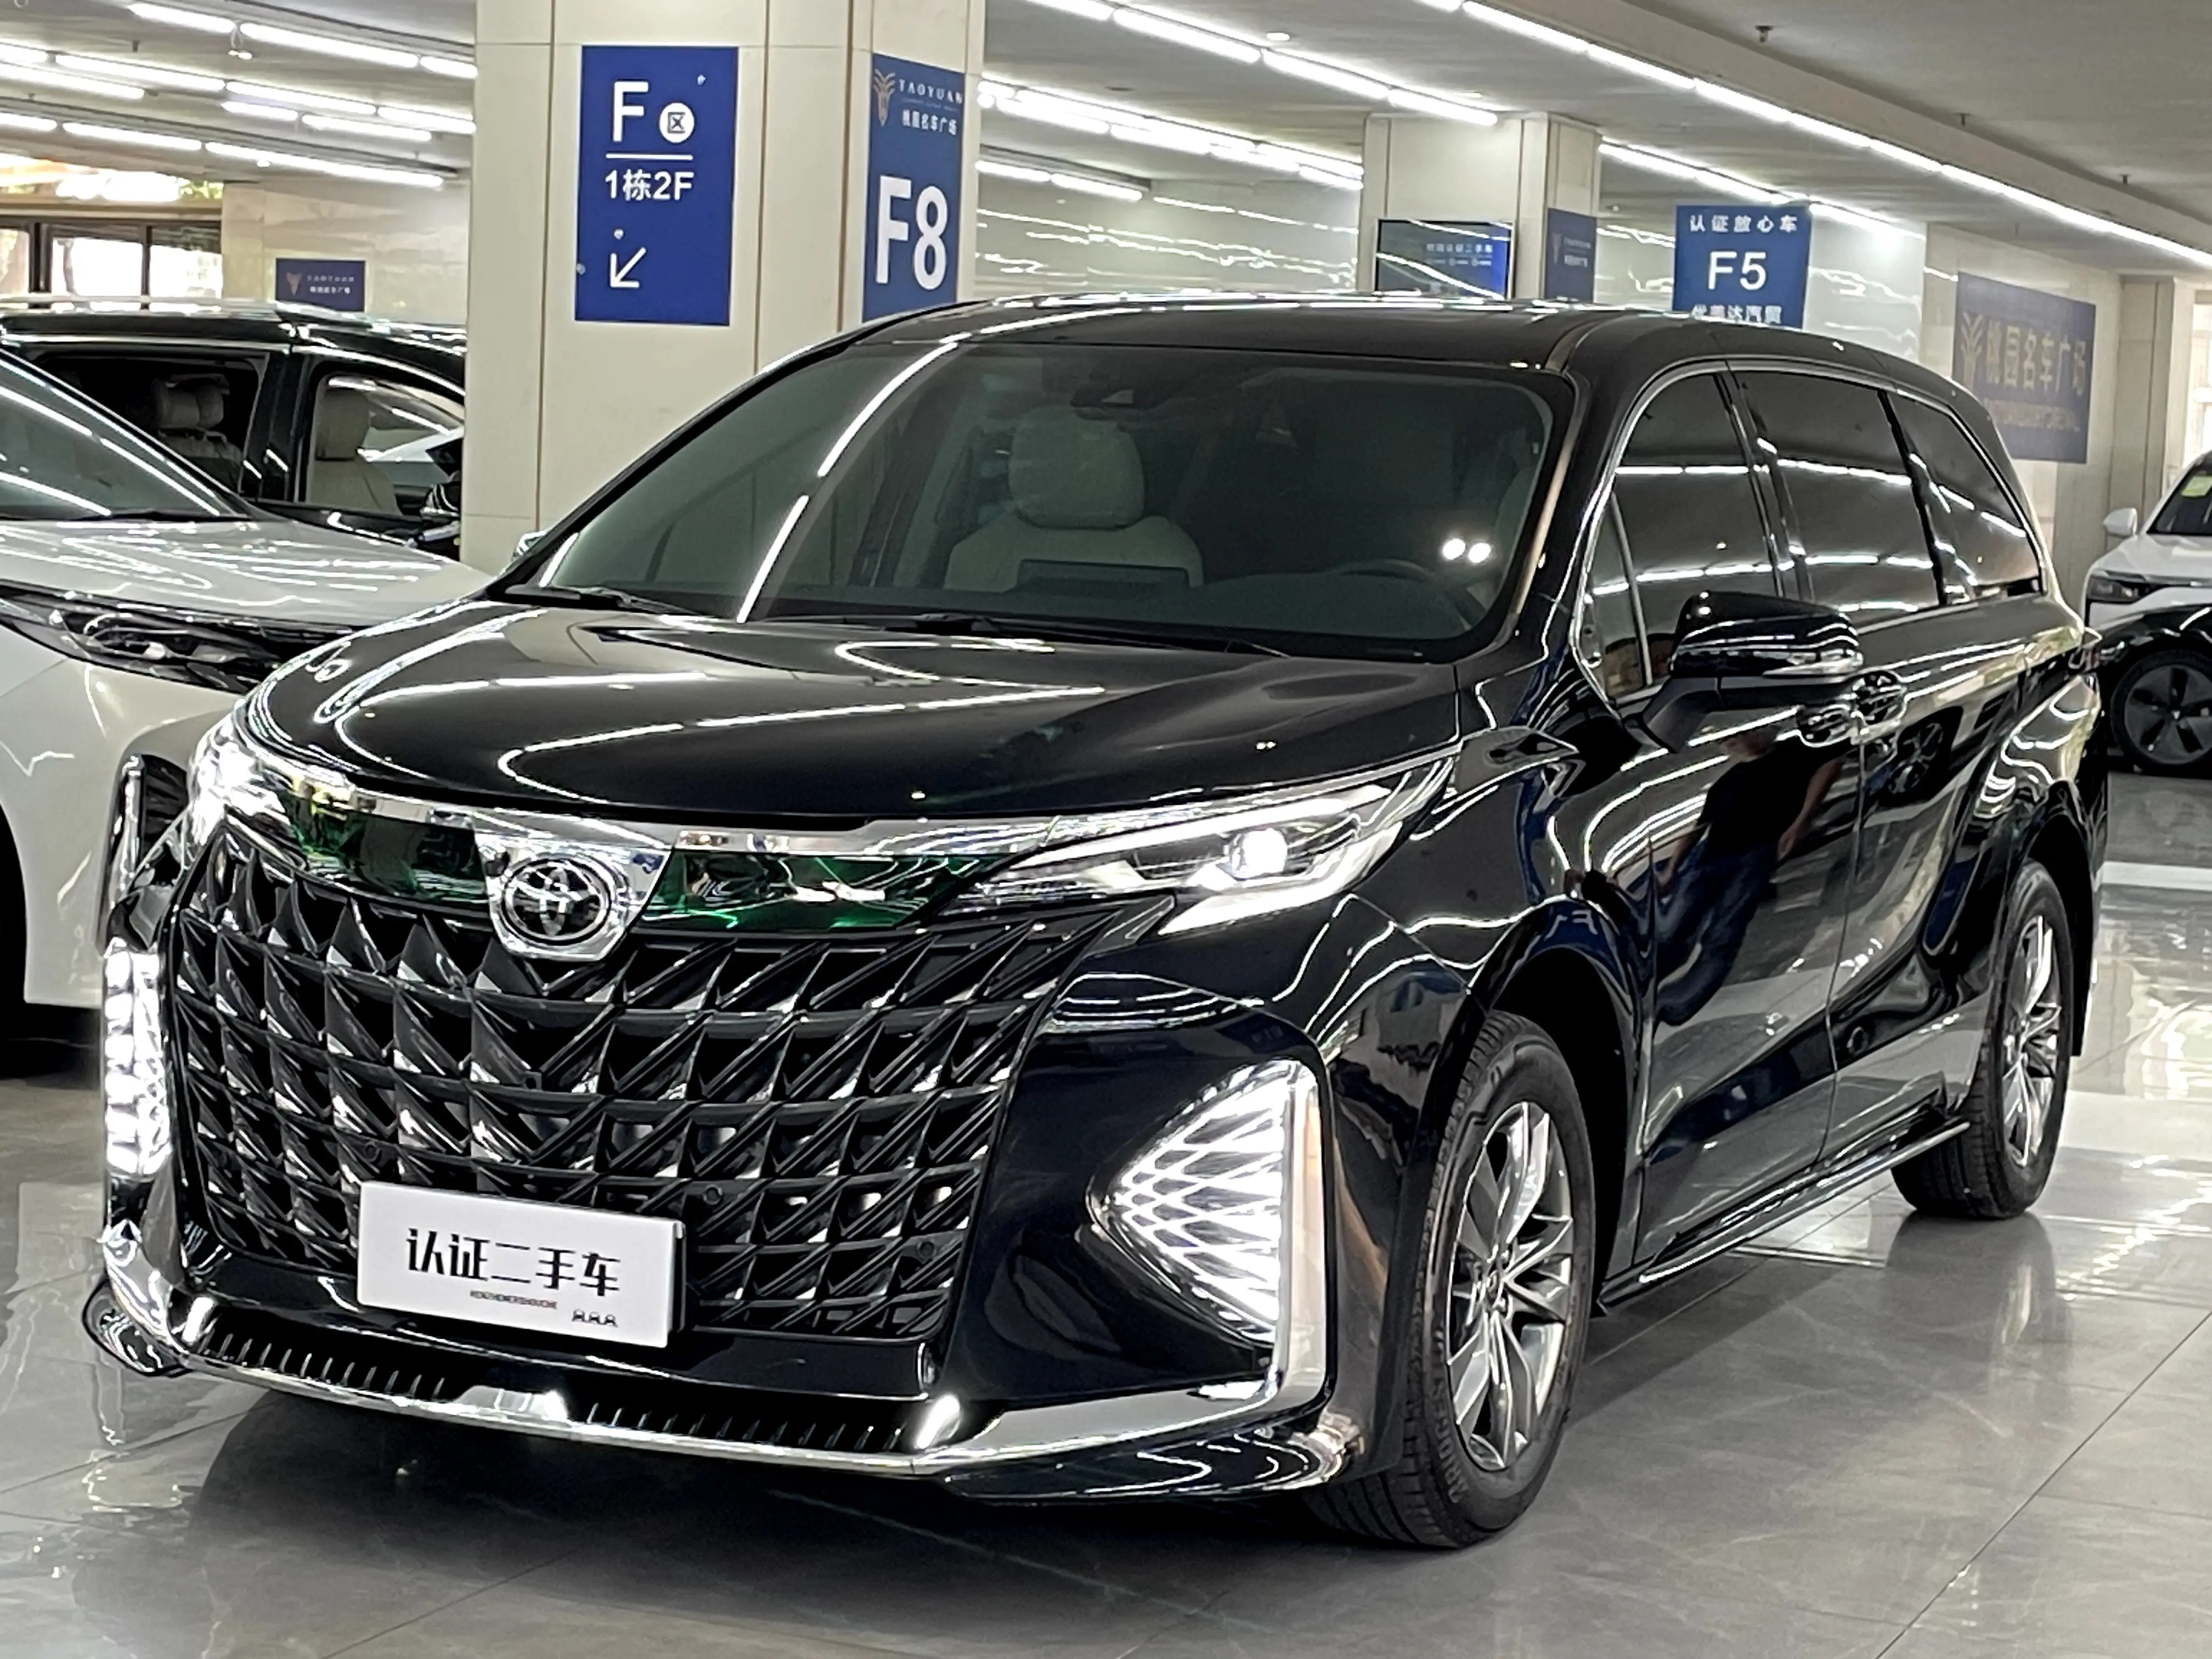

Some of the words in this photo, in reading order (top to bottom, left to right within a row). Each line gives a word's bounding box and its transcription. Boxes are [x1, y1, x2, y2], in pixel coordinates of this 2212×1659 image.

[899, 78, 963, 104] TAOYUAN
[613, 81, 648, 142] F
[605, 168, 695, 201] 1栋2F
[876, 175, 948, 290] F8
[1690, 215, 1798, 233] 认证放心车
[1708, 251, 1767, 290] F5
[406, 1227, 621, 1297] 认证二手车
